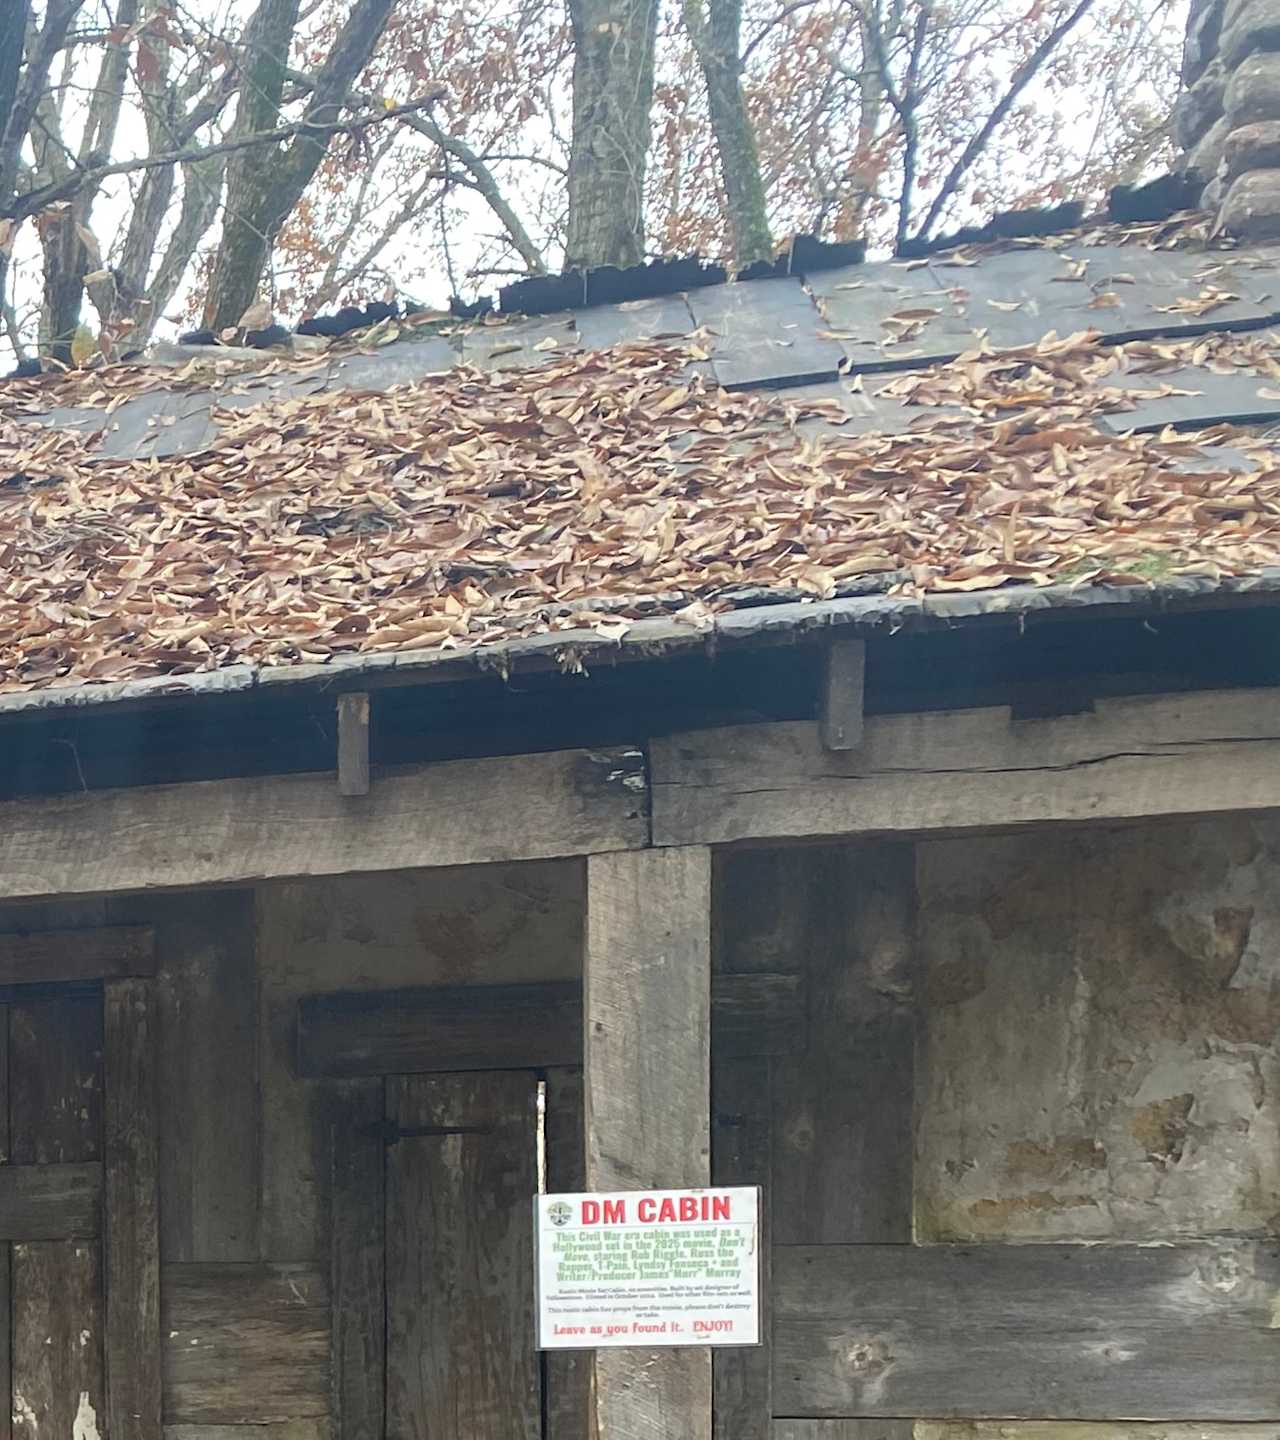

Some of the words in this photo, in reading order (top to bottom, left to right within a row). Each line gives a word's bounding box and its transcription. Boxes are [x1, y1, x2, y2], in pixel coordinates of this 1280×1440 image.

[581, 1199, 626, 1225] DM
[637, 1196, 731, 1223] CABIN
[556, 1232, 576, 1241] This
[579, 1231, 600, 1241] Civil
[603, 1231, 621, 1240] War
[624, 1232, 640, 1240] era
[643, 1230, 670, 1239] cabin
[673, 1230, 690, 1238] was
[694, 1228, 717, 1238] used
[720, 1229, 731, 1237] as
[552, 1242, 602, 1252] Hollywood
[605, 1241, 620, 1250] set
[623, 1240, 633, 1250] in
[635, 1240, 652, 1249] the
[655, 1239, 681, 1249] 2025
[593, 1251, 628, 1261] staring
[631, 1250, 650, 1260] Rob
[717, 1248, 734, 1257] the
[720, 1258, 739, 1267] and
[705, 1268, 741, 1278] Murray
[554, 1324, 586, 1335] Leave
[590, 1326, 602, 1334] as
[607, 1325, 628, 1336] you
[632, 1321, 666, 1333] found
[693, 1320, 733, 1332] ENJOY!
